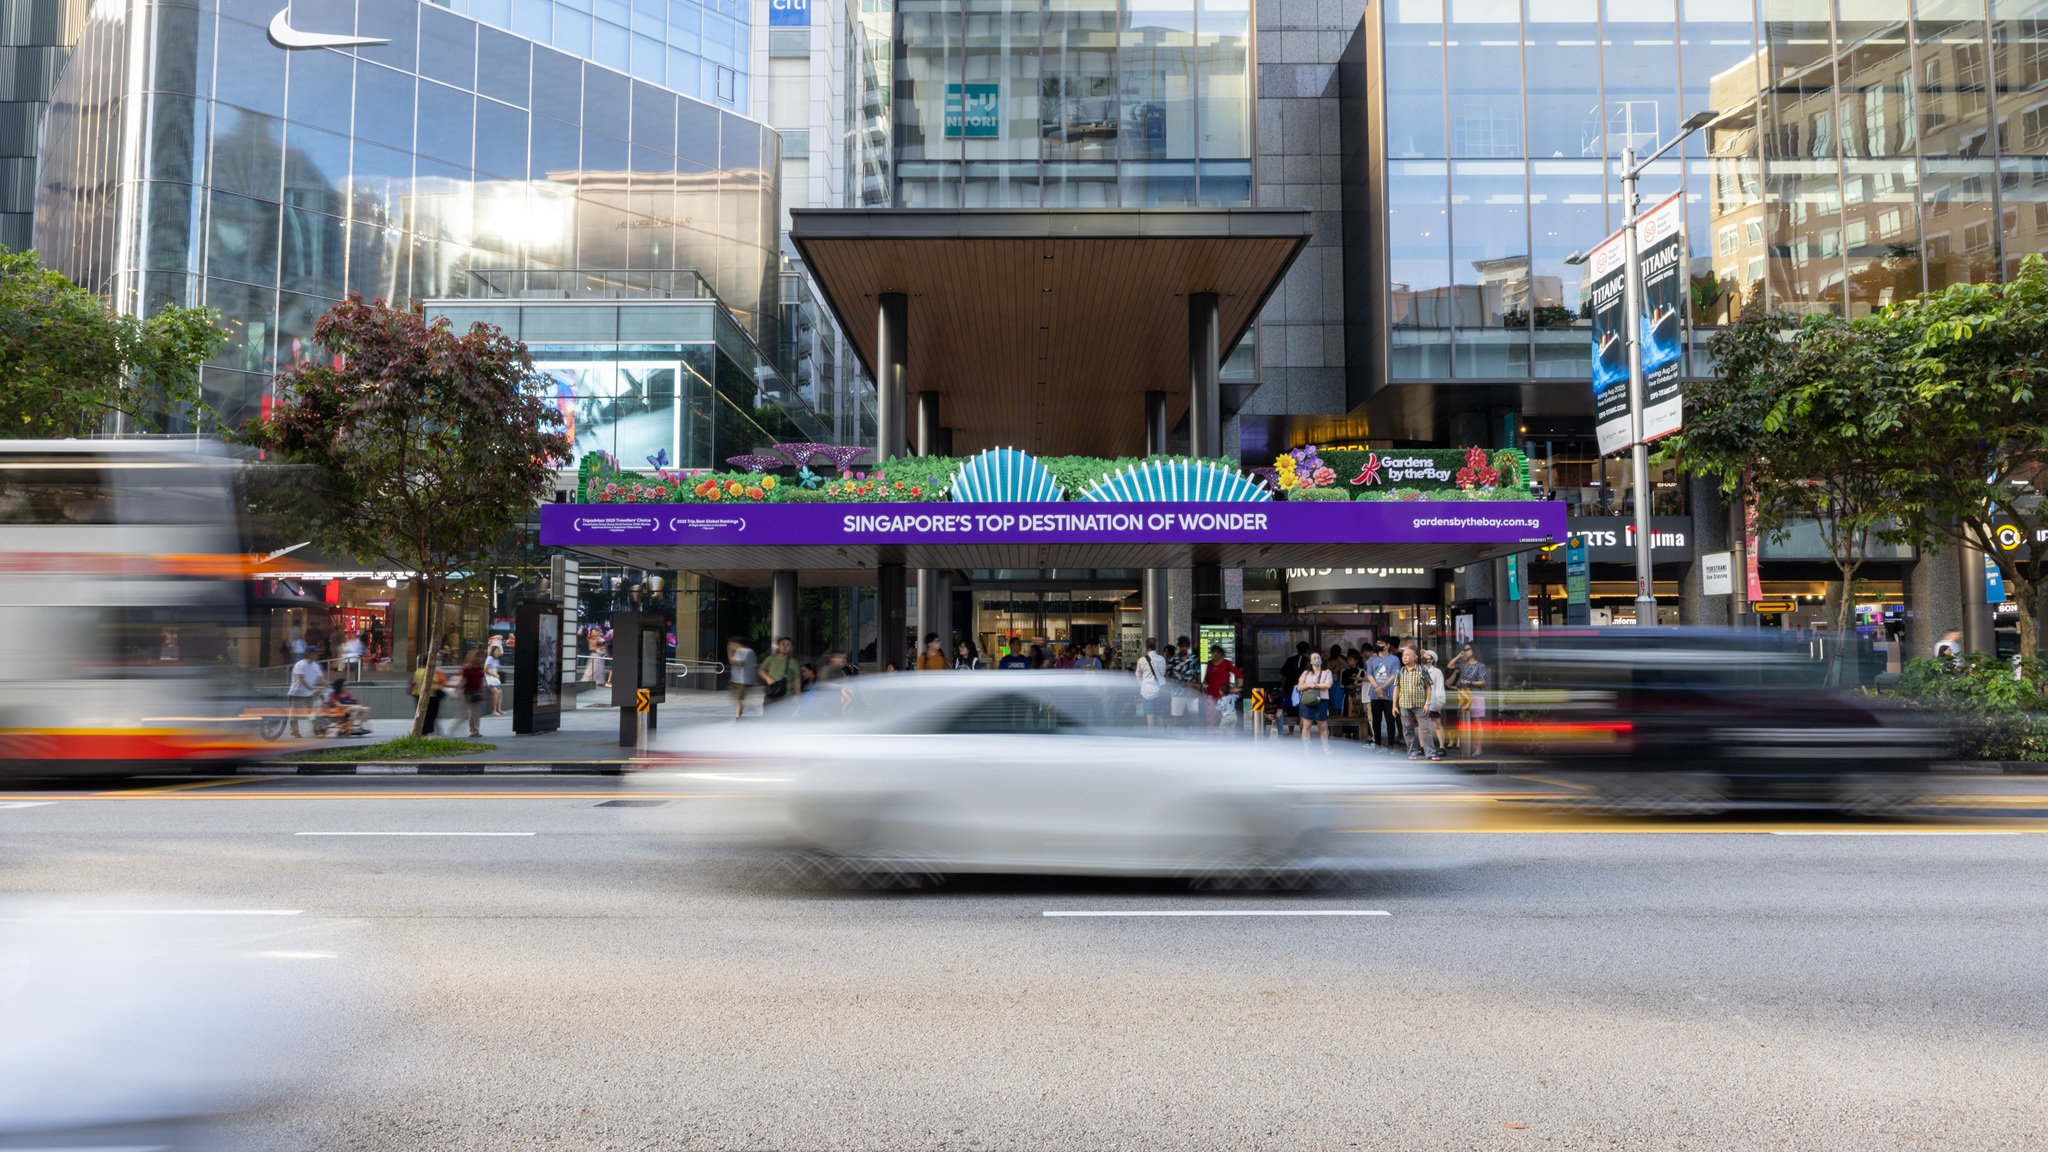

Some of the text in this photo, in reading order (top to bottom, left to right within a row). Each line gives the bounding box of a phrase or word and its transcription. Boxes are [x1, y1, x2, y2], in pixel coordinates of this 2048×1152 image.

[947, 93, 996, 112] ニトリ
[946, 116, 996, 127] NITORI
[1641, 243, 1678, 277] TITANIC
[1593, 273, 1624, 306] TITANIC
[1661, 366, 1671, 376] Aug
[1381, 456, 1434, 468] Gardens
[1388, 468, 1451, 482] by the Bay
[843, 514, 1268, 532] SINGAPORE'S TOP DESTINATION OF WONDER
[1413, 517, 1540, 528] gardensbythebay.com.sg
[1705, 564, 1728, 572] PEDESTRIANS
